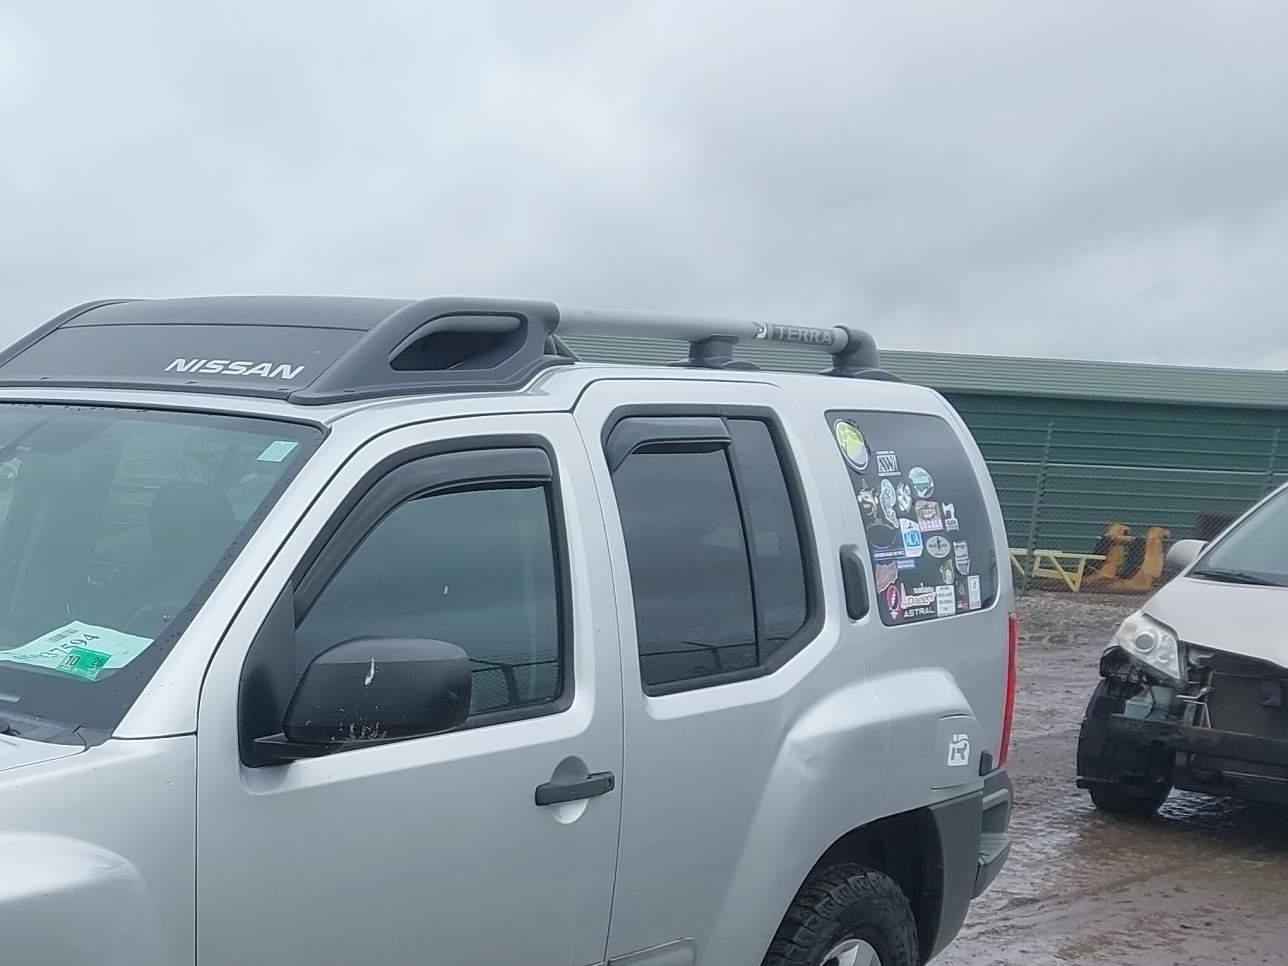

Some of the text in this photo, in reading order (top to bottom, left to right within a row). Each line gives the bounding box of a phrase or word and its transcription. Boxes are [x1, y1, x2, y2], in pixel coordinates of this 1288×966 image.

[163, 358, 305, 380] NISSAN
[903, 606, 936, 618] ASTRAL
[64, 655, 81, 666] 10
